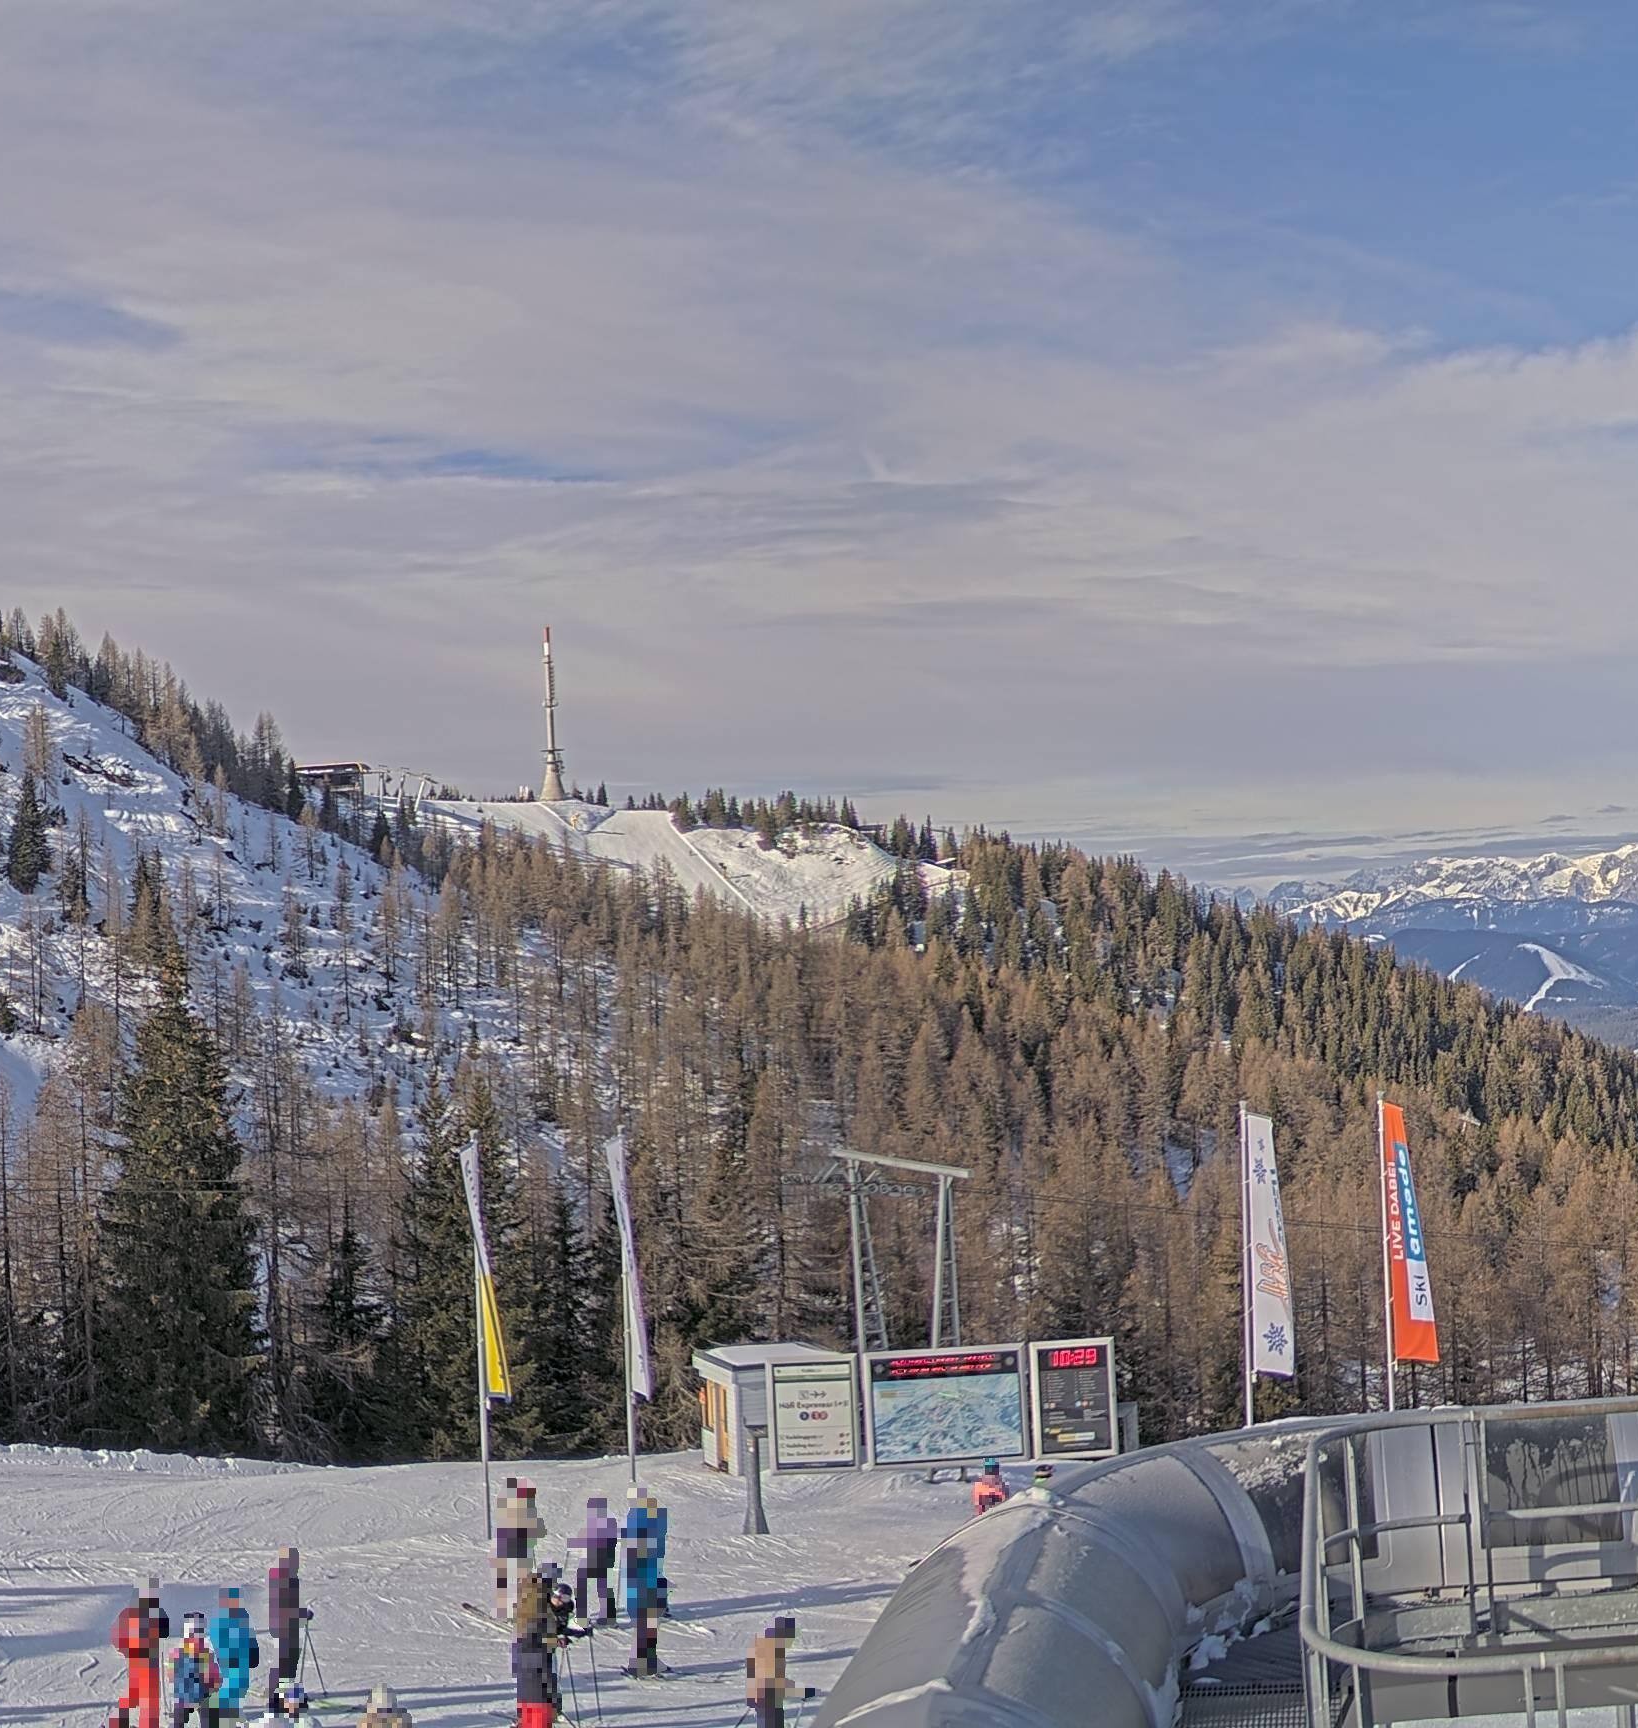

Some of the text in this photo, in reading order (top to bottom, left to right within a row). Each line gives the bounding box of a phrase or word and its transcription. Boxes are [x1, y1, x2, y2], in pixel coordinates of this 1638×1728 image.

[1387, 1161, 1404, 1260] LIVE DABEI
[1051, 1348, 1097, 1367] 10:29
